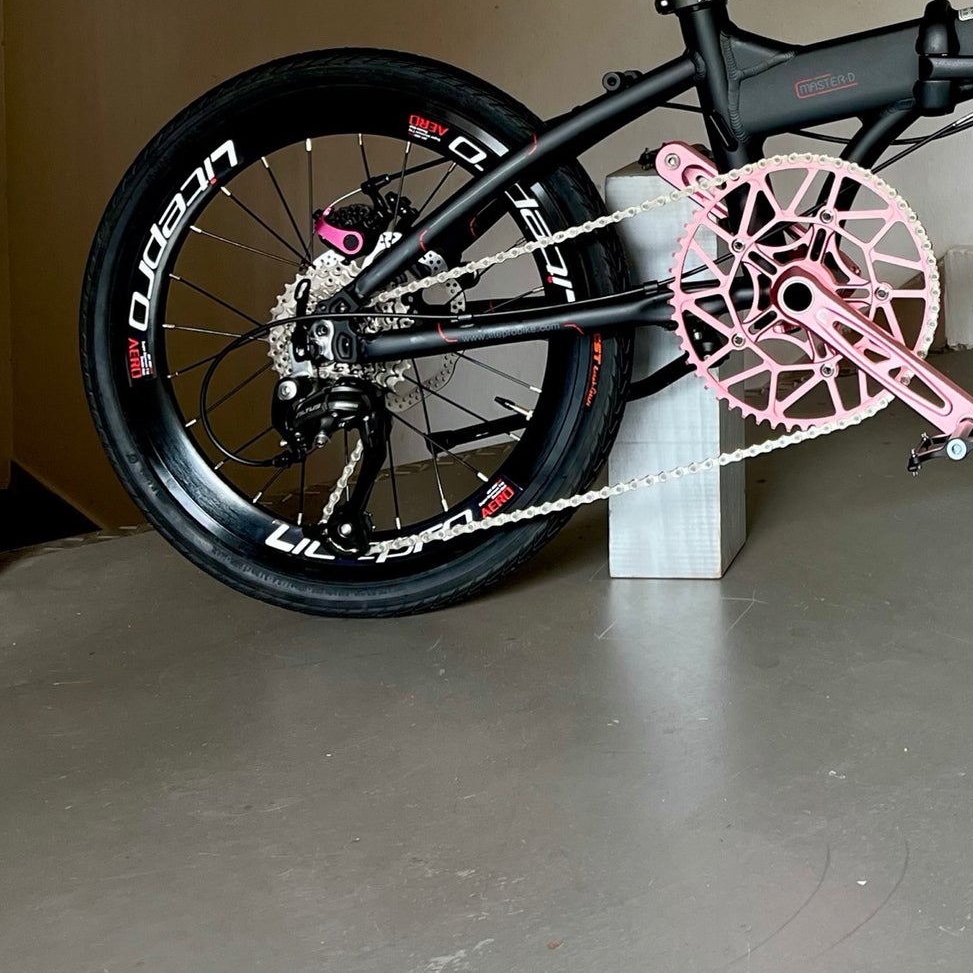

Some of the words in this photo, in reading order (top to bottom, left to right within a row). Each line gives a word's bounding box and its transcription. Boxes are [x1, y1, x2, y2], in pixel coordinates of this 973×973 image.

[409, 114, 449, 136] AERO
[128, 338, 143, 379] AERO
[480, 485, 515, 519] AERO
